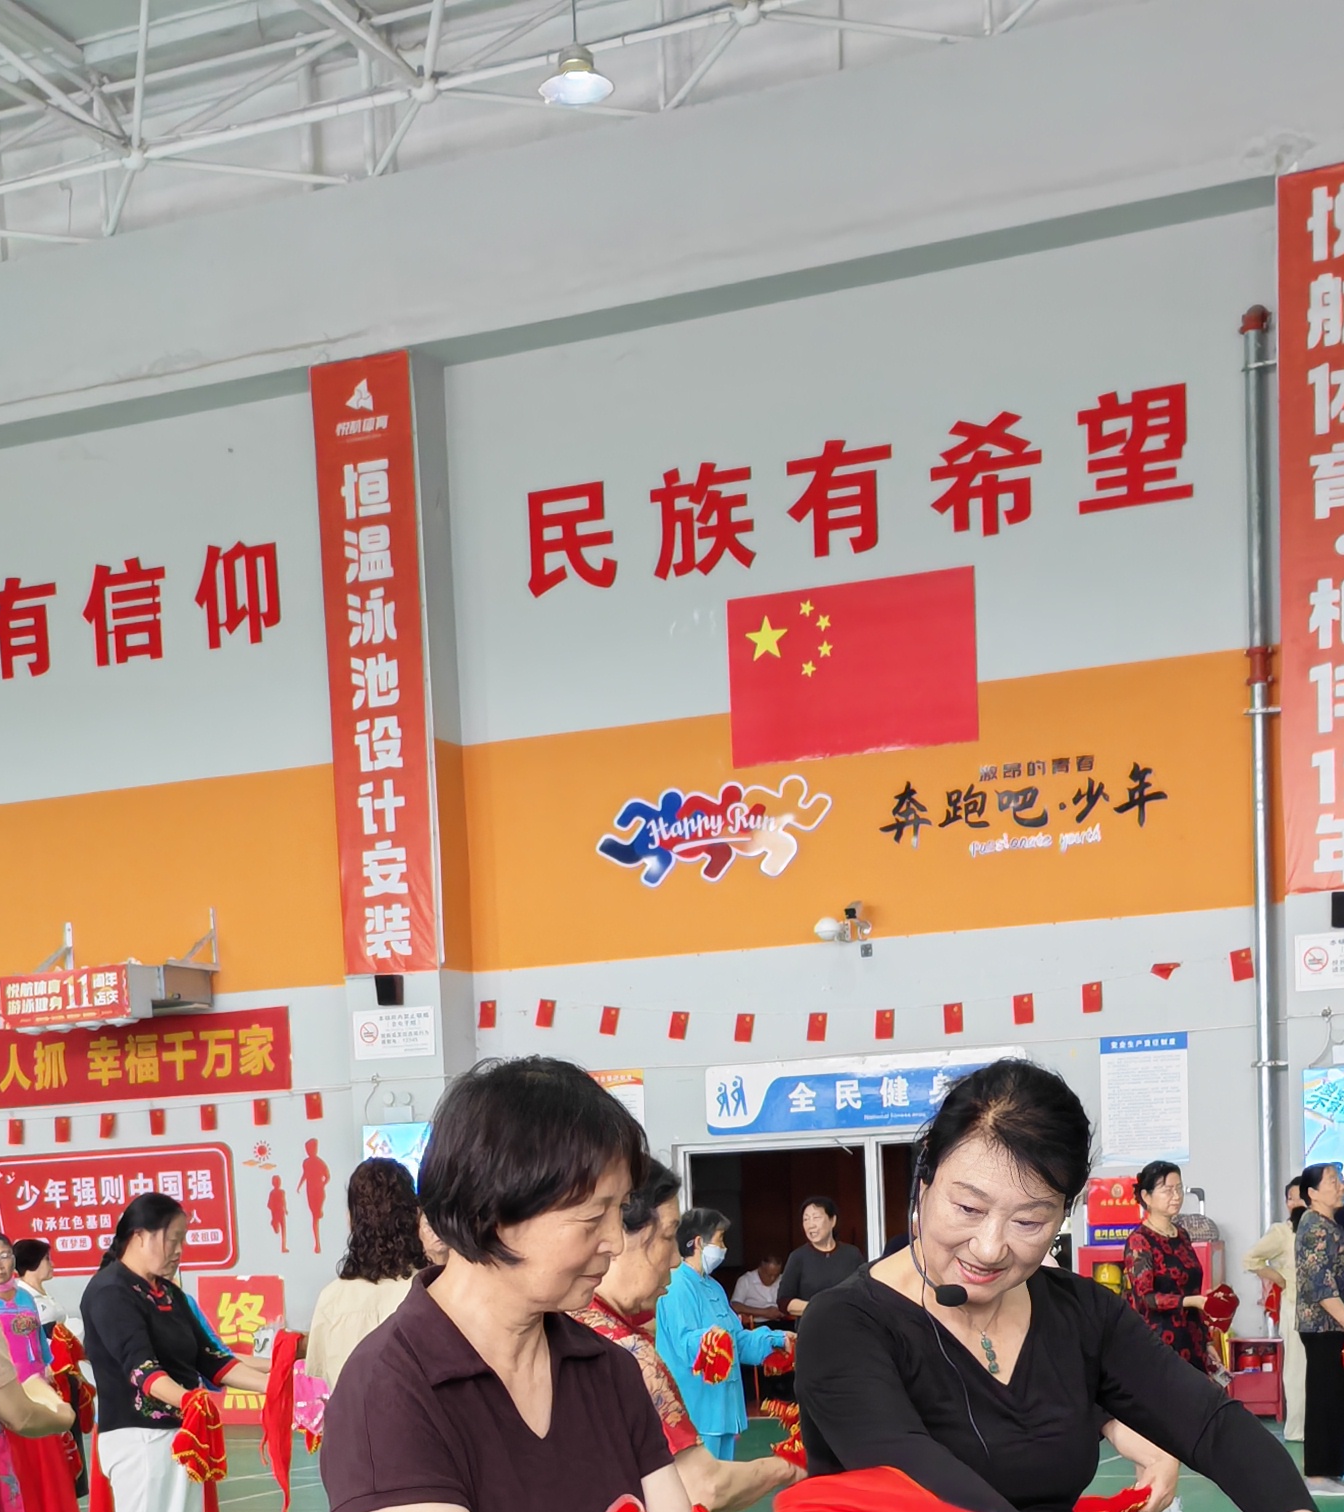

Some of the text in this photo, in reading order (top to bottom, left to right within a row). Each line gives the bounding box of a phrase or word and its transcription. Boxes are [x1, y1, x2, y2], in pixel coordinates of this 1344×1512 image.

[527, 382, 1194, 598] 民族有希望
[341, 458, 412, 959] 恒温泳池设计安装
[646, 802, 776, 849] Happy Run
[63, 973, 93, 1009] 11
[87, 1024, 276, 1087] 幸福千万家
[16, 1169, 215, 1211] 少年强则中国强
[32, 1213, 112, 1233] 传承红色基因
